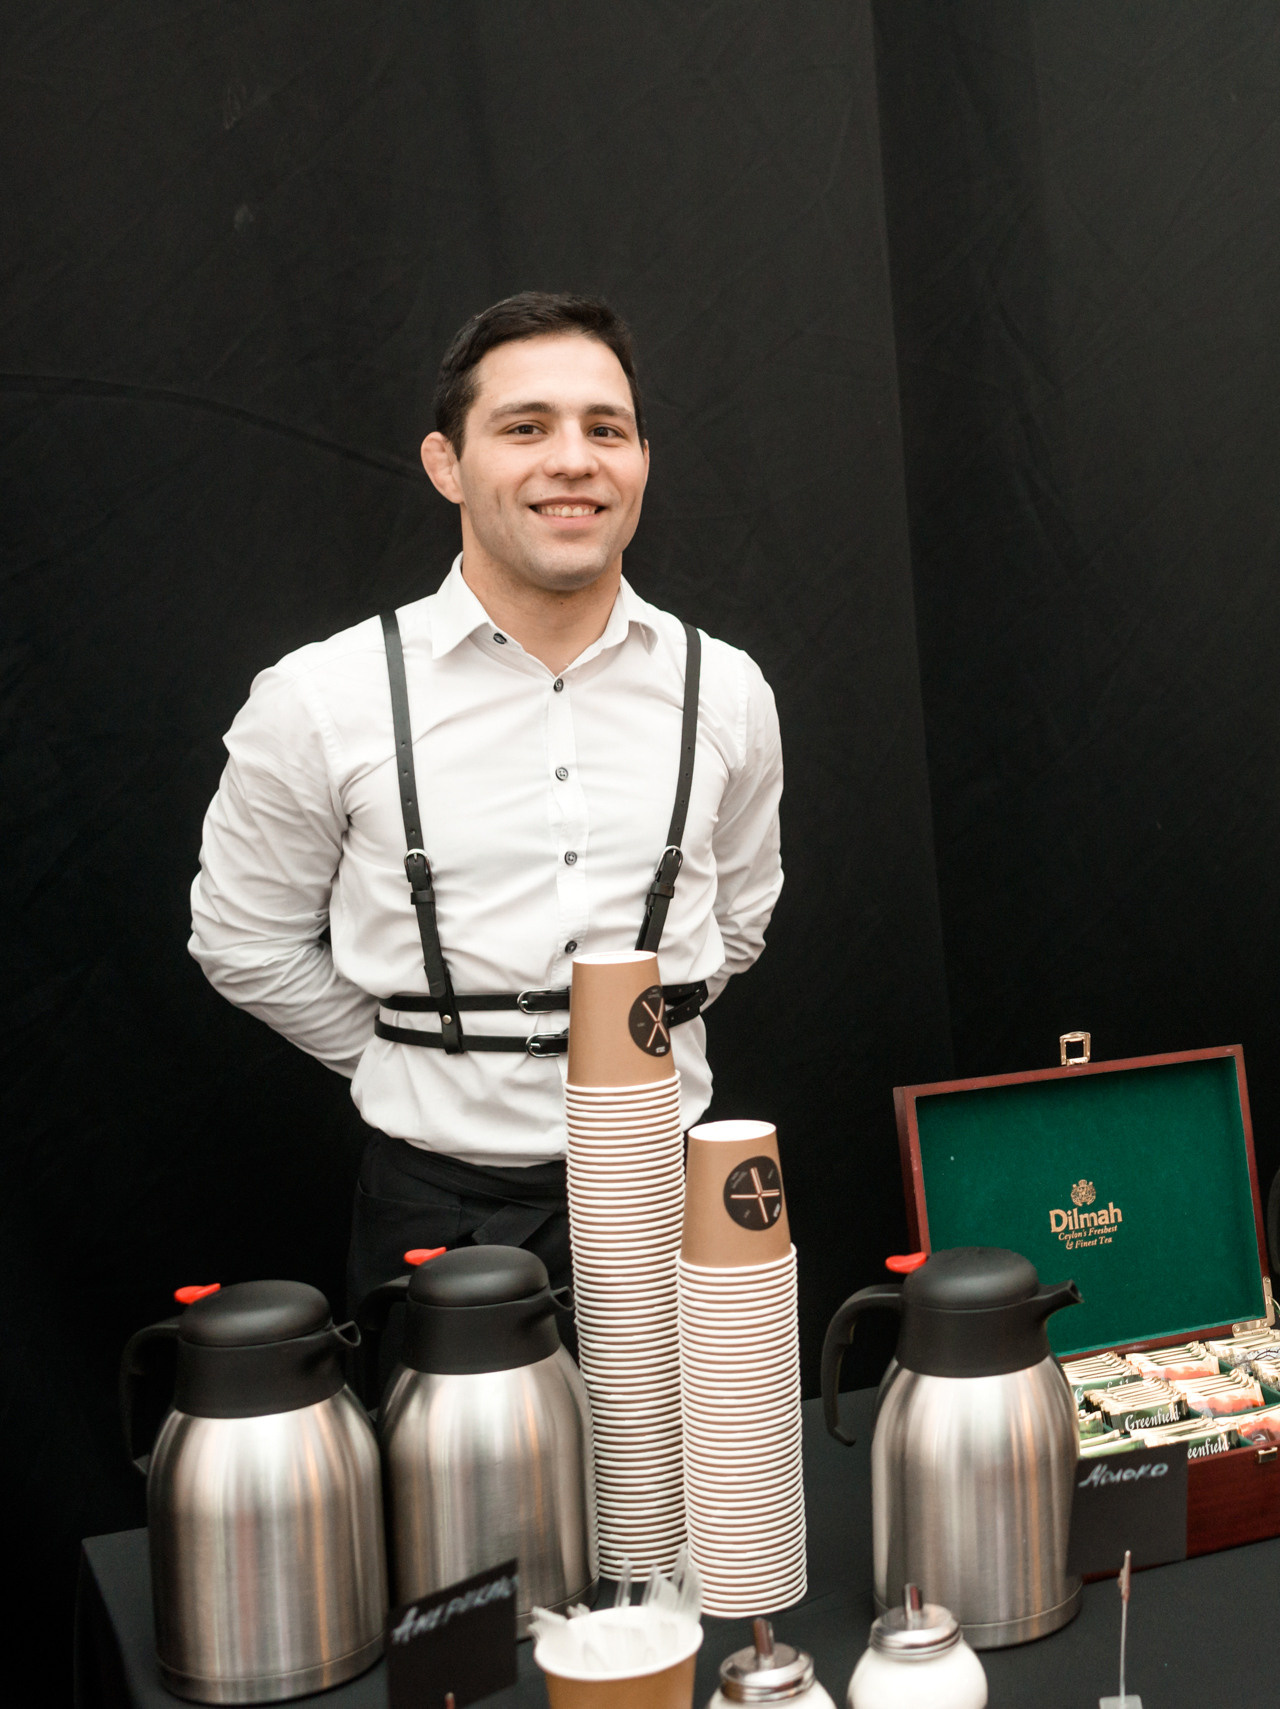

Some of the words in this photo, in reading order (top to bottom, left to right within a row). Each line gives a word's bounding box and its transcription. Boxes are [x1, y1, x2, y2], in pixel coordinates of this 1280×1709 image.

[1048, 1201, 1123, 1233] Dilmah
[1058, 1229, 1087, 1241] Ceylon's
[1088, 1225, 1118, 1236] Freshest
[1075, 1238, 1098, 1249] Finest
[1098, 1235, 1113, 1245] Tea
[1124, 1405, 1181, 1431] Greenfield
[1187, 1434, 1230, 1459] eenfield
